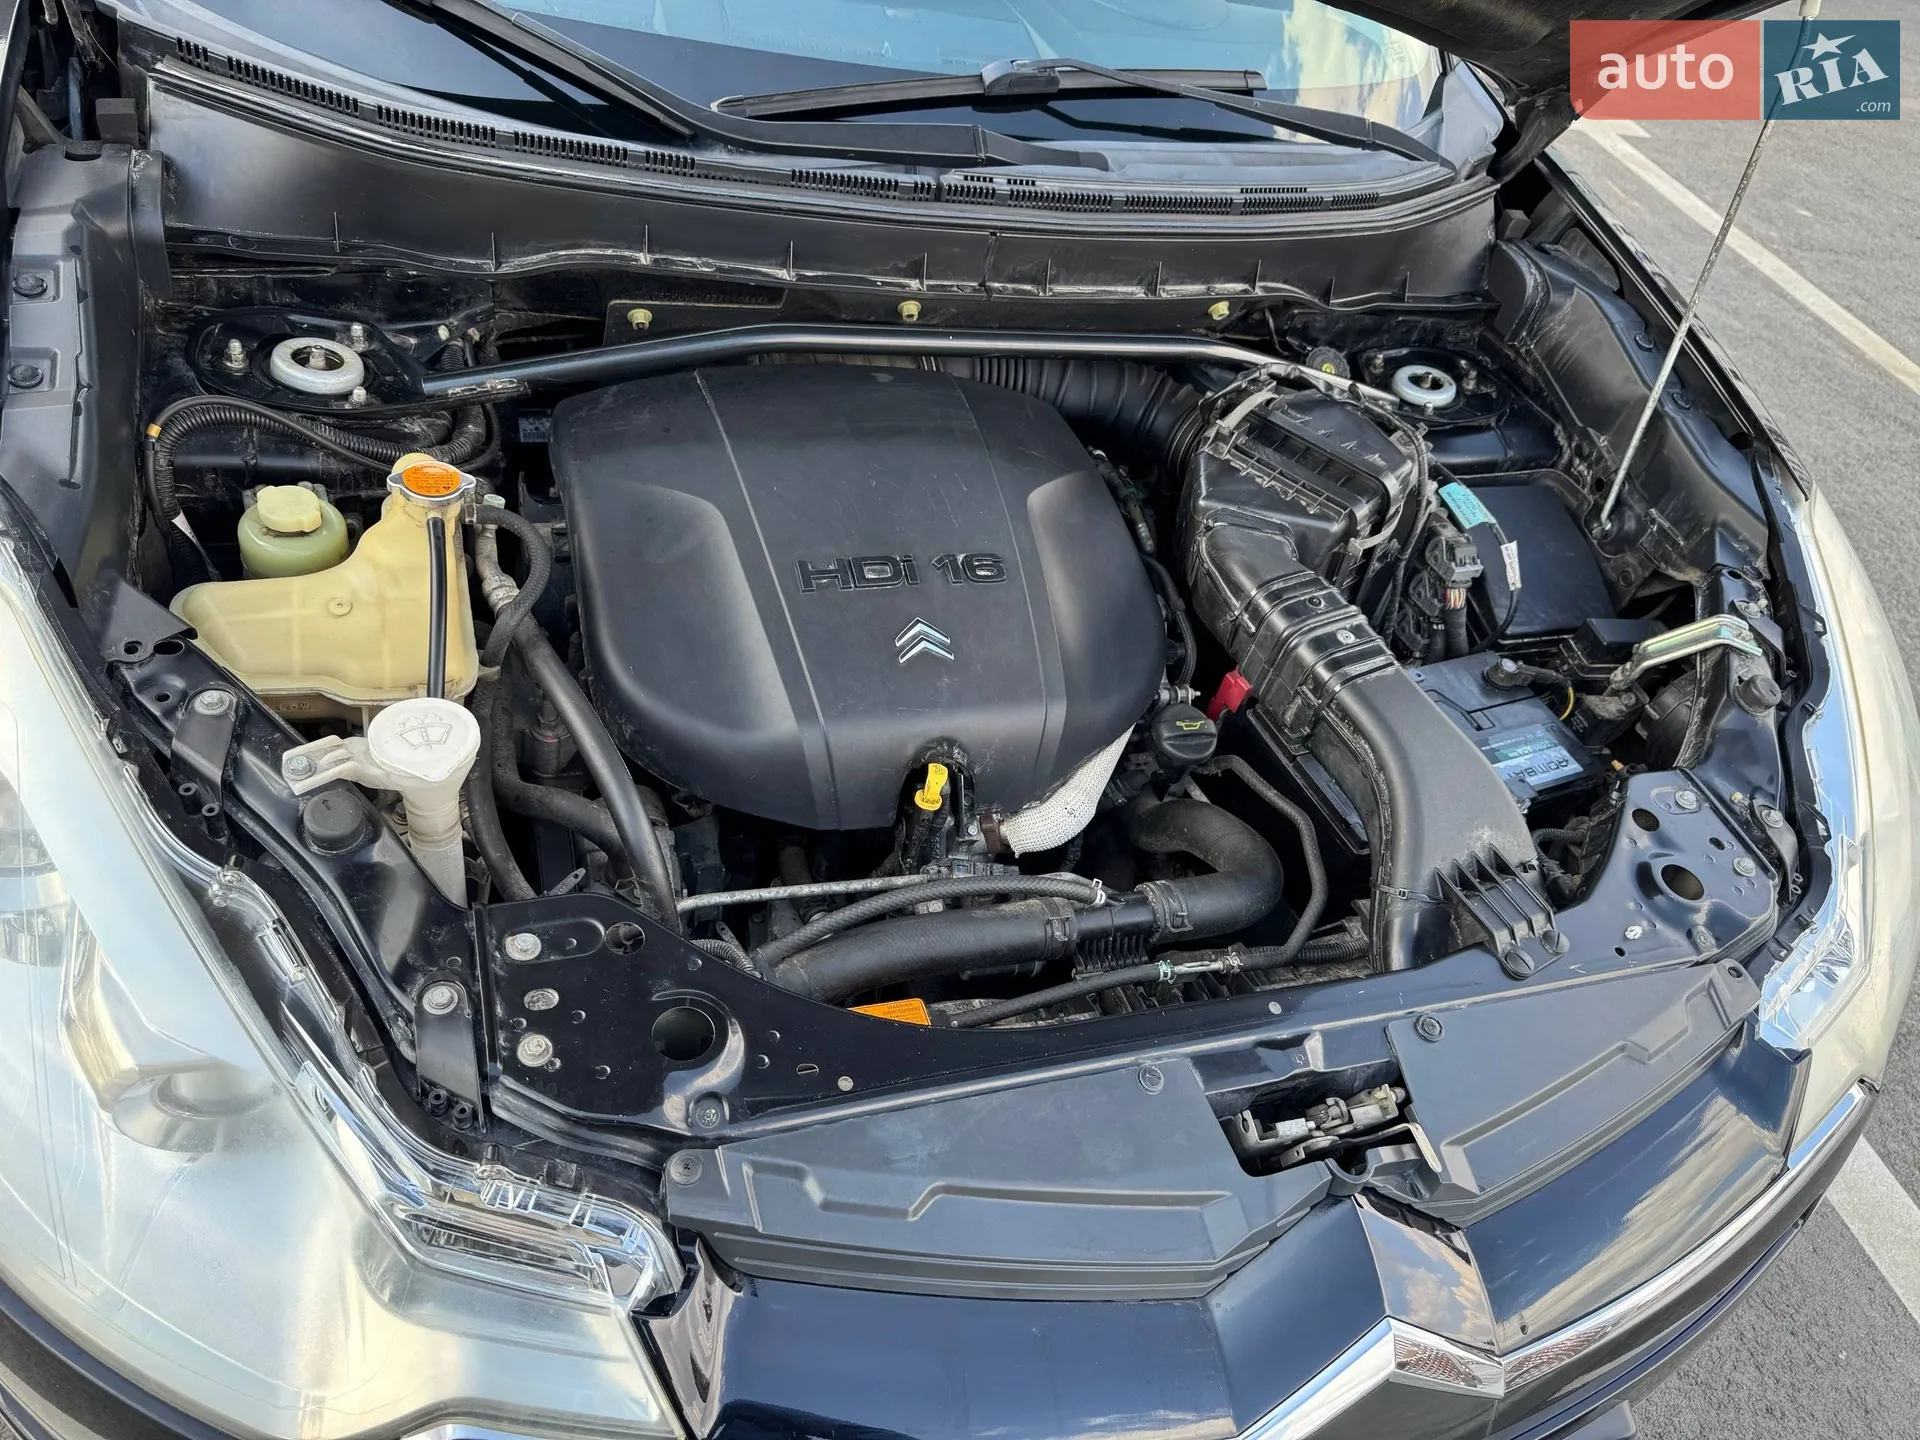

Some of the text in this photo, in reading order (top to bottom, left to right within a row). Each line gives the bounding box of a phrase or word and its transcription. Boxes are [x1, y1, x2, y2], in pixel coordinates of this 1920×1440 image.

[794, 553, 1008, 593] HDi 16
[886, 1002, 914, 1010] WARNING
